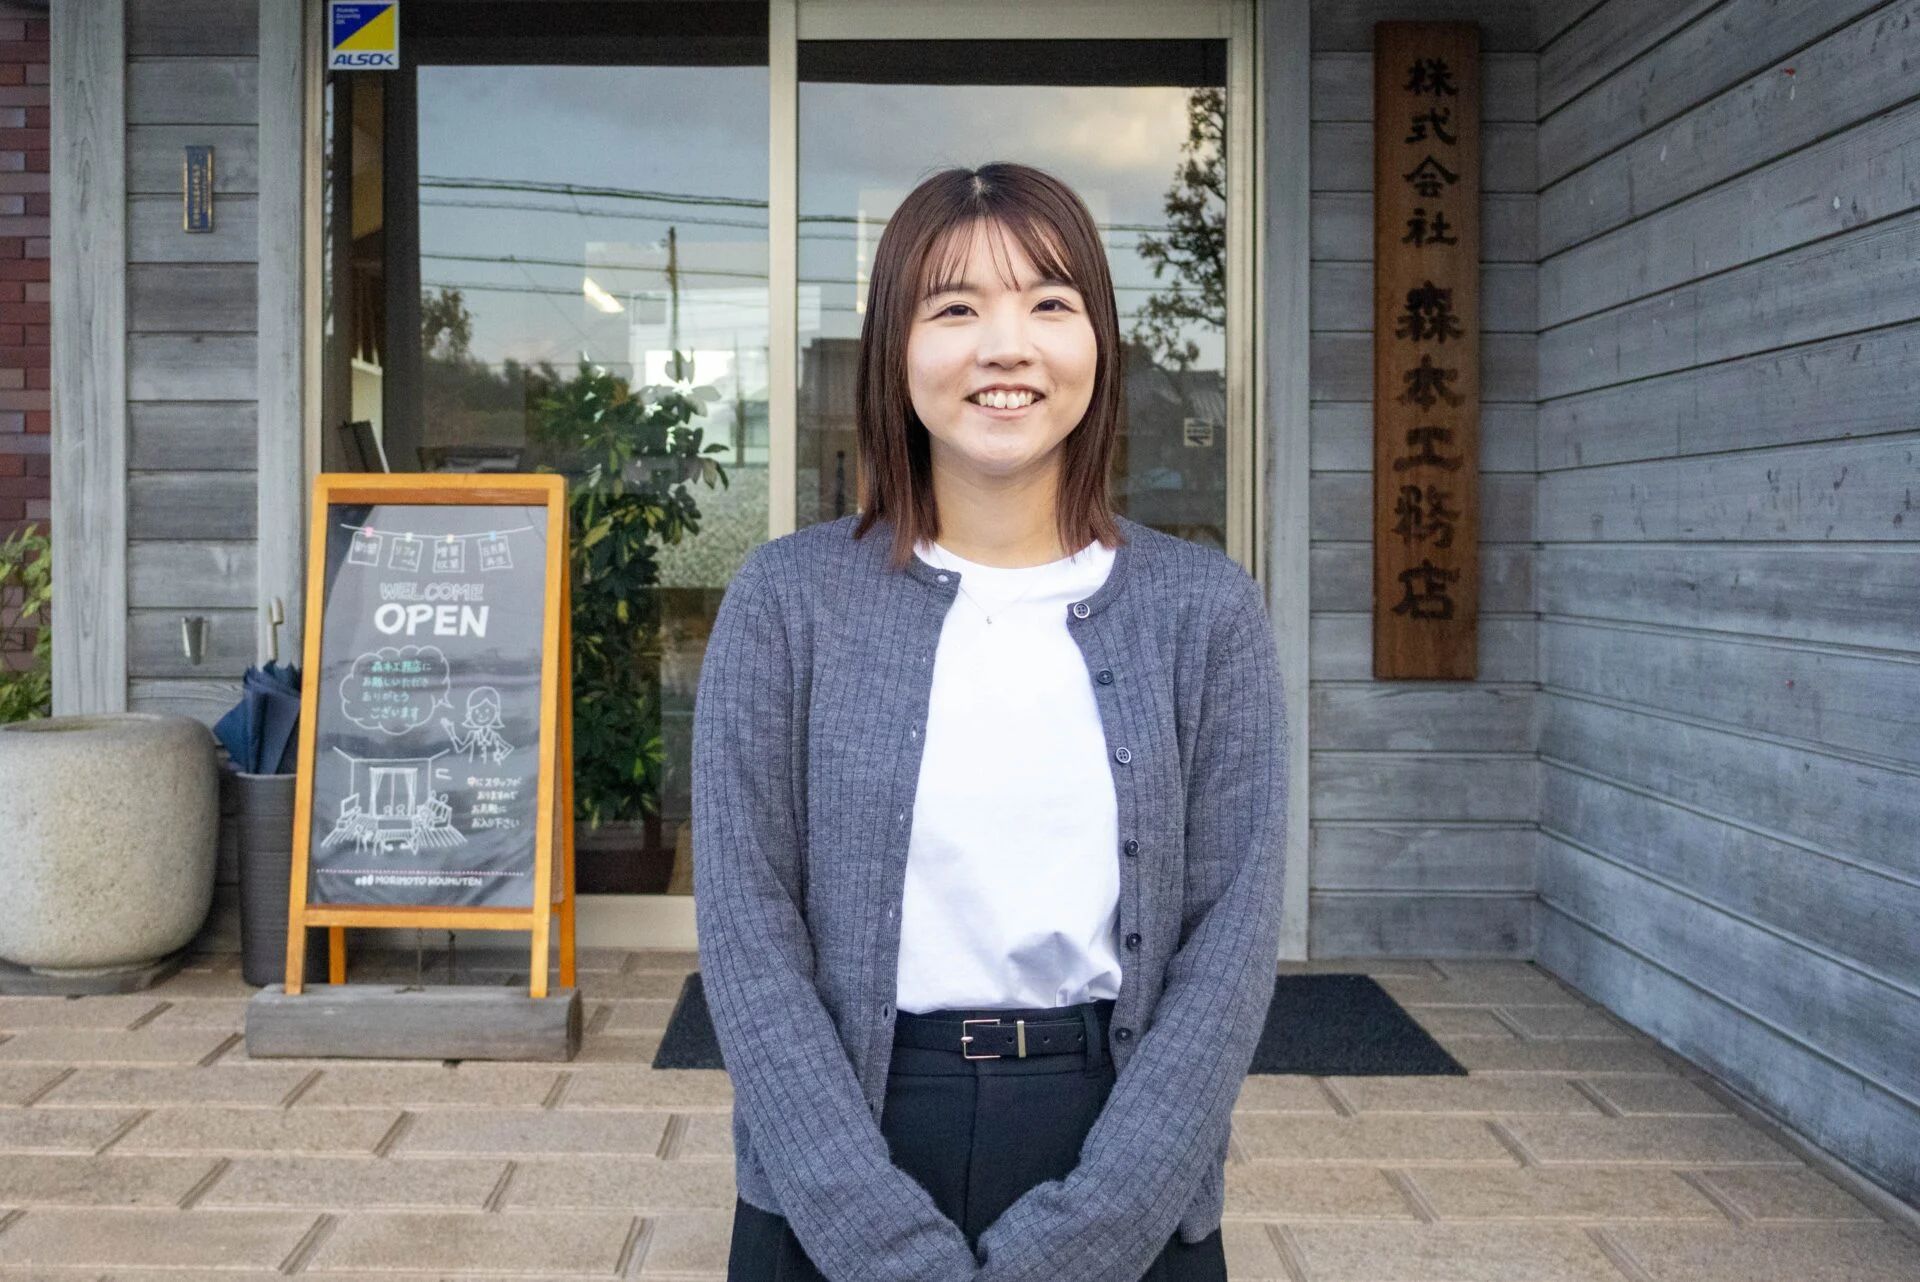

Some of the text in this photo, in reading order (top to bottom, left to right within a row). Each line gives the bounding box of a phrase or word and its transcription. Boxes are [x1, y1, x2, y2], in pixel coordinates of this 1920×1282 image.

[333, 53, 394, 66] ALSOK
[1391, 56, 1465, 622] 株式会社 森本工務店
[379, 581, 485, 602] WELCOME
[374, 603, 489, 638] OPEN
[362, 690, 409, 702] ありがとう
[370, 706, 419, 721] ございます
[375, 875, 483, 887] MORIMOTO KOUMUTEN
